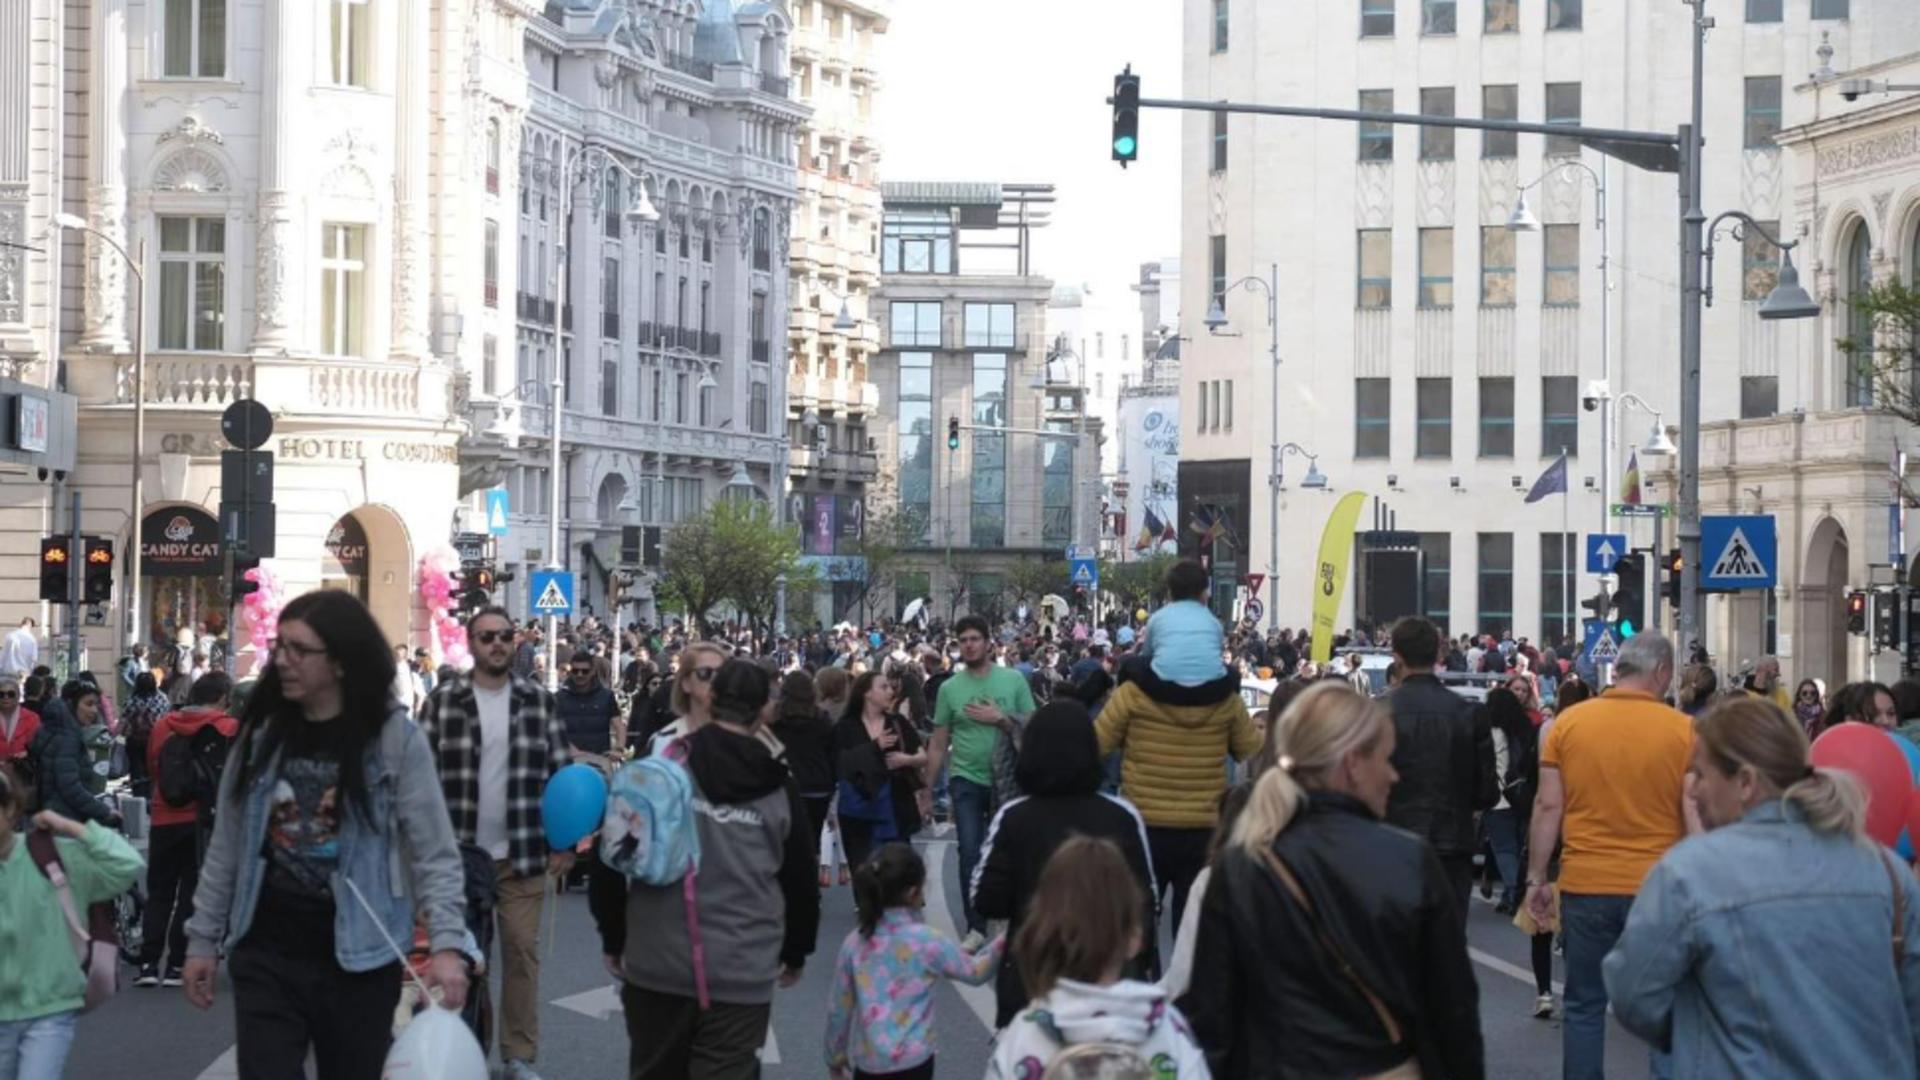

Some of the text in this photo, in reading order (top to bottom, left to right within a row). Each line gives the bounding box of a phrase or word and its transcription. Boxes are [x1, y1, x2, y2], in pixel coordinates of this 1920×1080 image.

[278, 438, 367, 459] HOTEL
[141, 543, 219, 557] CANDY CAT
[342, 545, 366, 558] CAT
